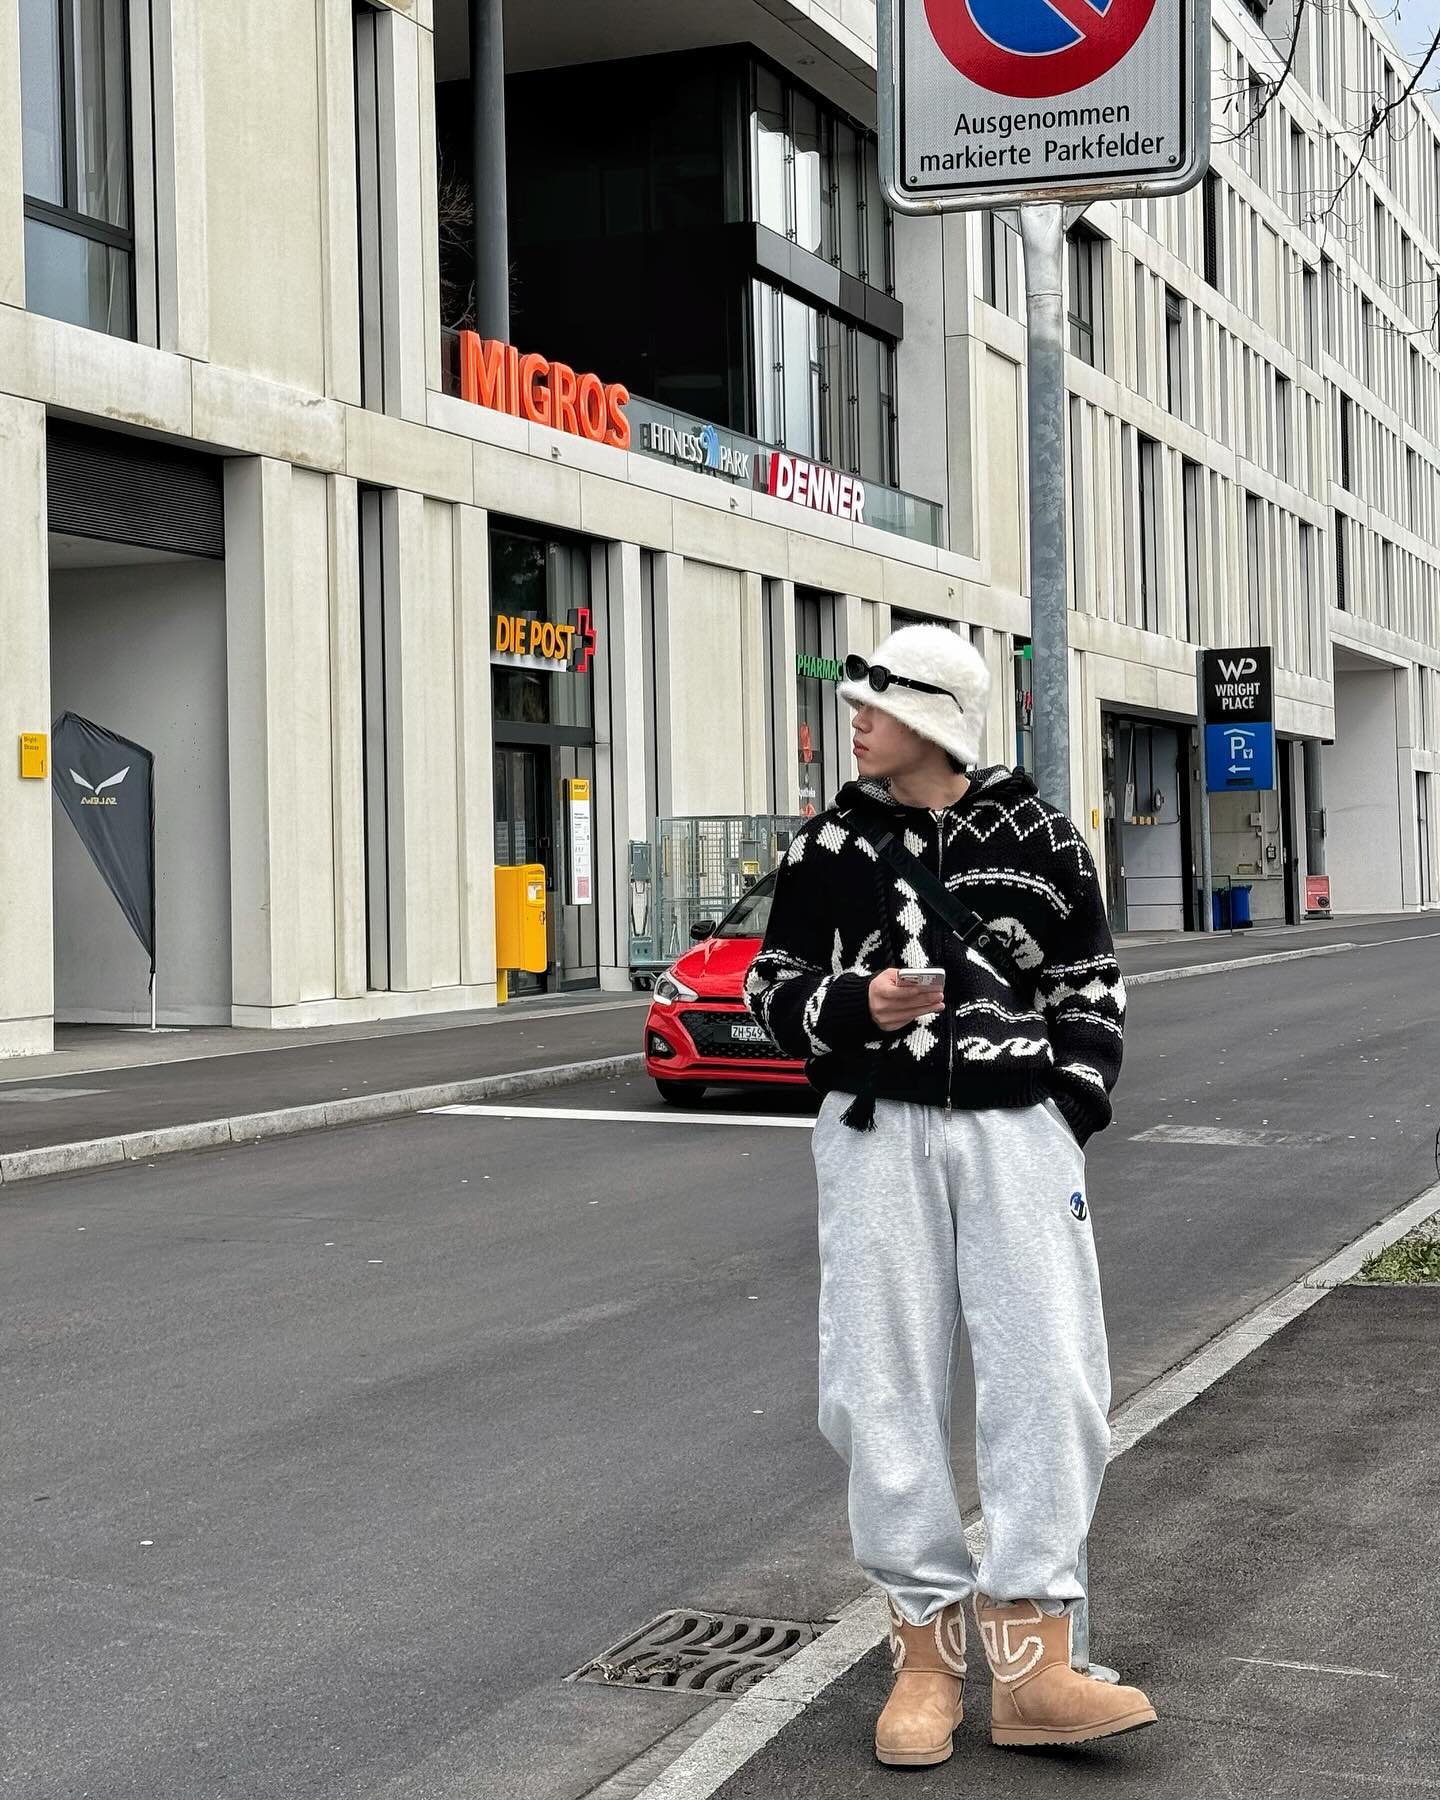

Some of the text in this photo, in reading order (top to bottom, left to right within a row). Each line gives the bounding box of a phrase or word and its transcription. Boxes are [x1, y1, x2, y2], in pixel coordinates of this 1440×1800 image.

[953, 104, 1130, 138] Ausgenommen
[920, 131, 1165, 172] markierte Parkfelder
[459, 330, 631, 451] MIGROS
[651, 423, 750, 479] FITNESS PARK
[774, 453, 865, 523] DENNER
[496, 615, 575, 660] DIE POST
[797, 654, 844, 681] PHARMAC
[1215, 682, 1260, 697] WRIGHT
[1222, 696, 1255, 711] PLACE
